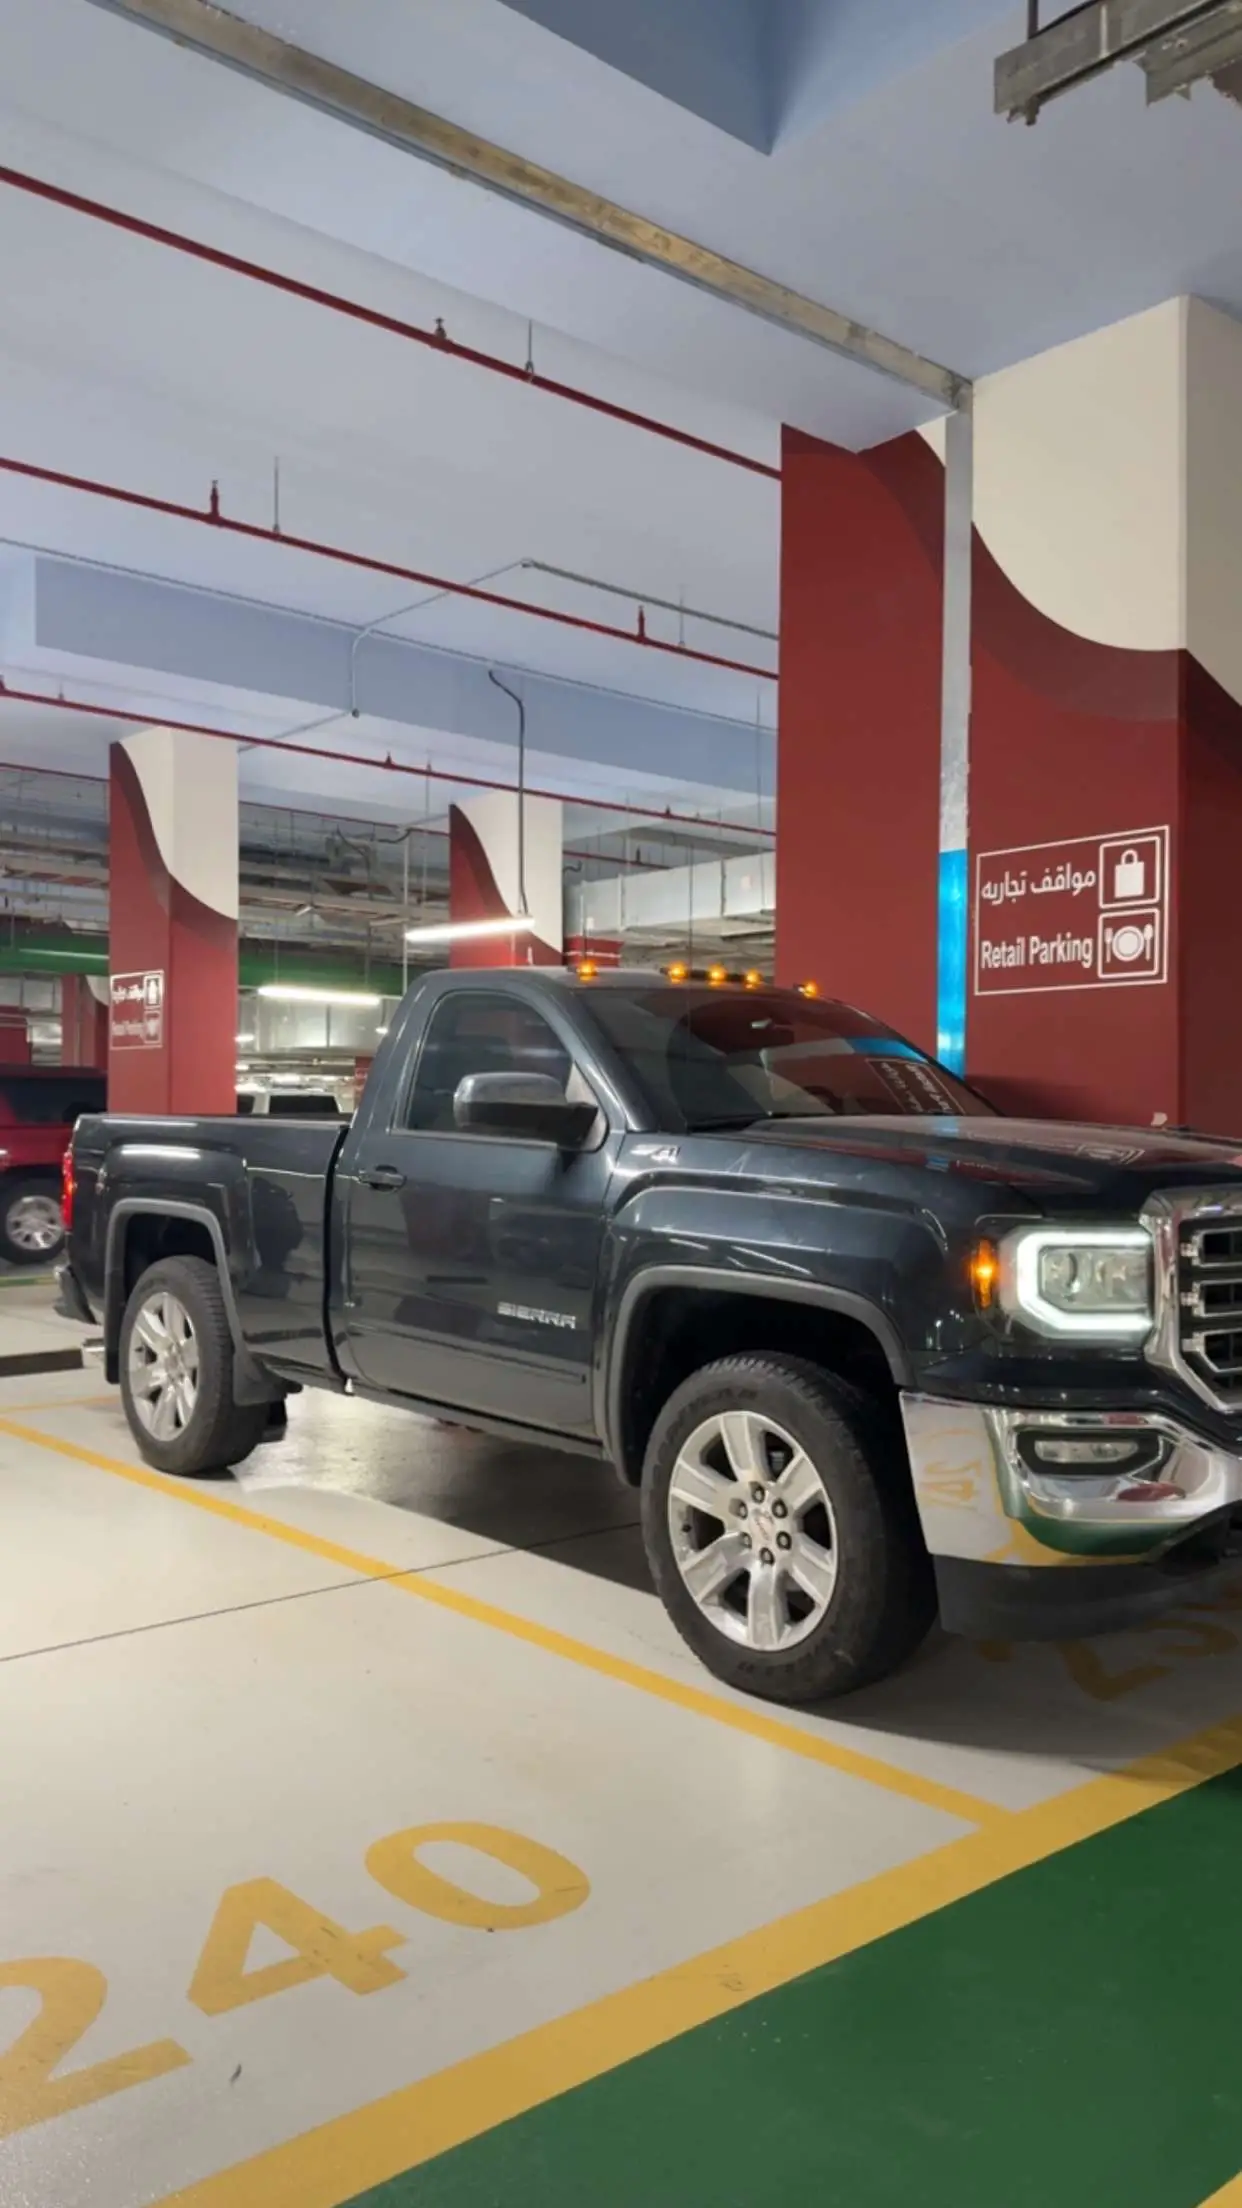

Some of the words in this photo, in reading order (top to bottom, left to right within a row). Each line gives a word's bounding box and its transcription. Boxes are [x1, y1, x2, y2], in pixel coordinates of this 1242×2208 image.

[1030, 862, 1096, 896] مواقف
[981, 937, 1025, 969] Retail
[1029, 932, 1093, 969] Parking
[497, 1301, 577, 1329] SIERRA
[0, 1821, 591, 2140] 240
